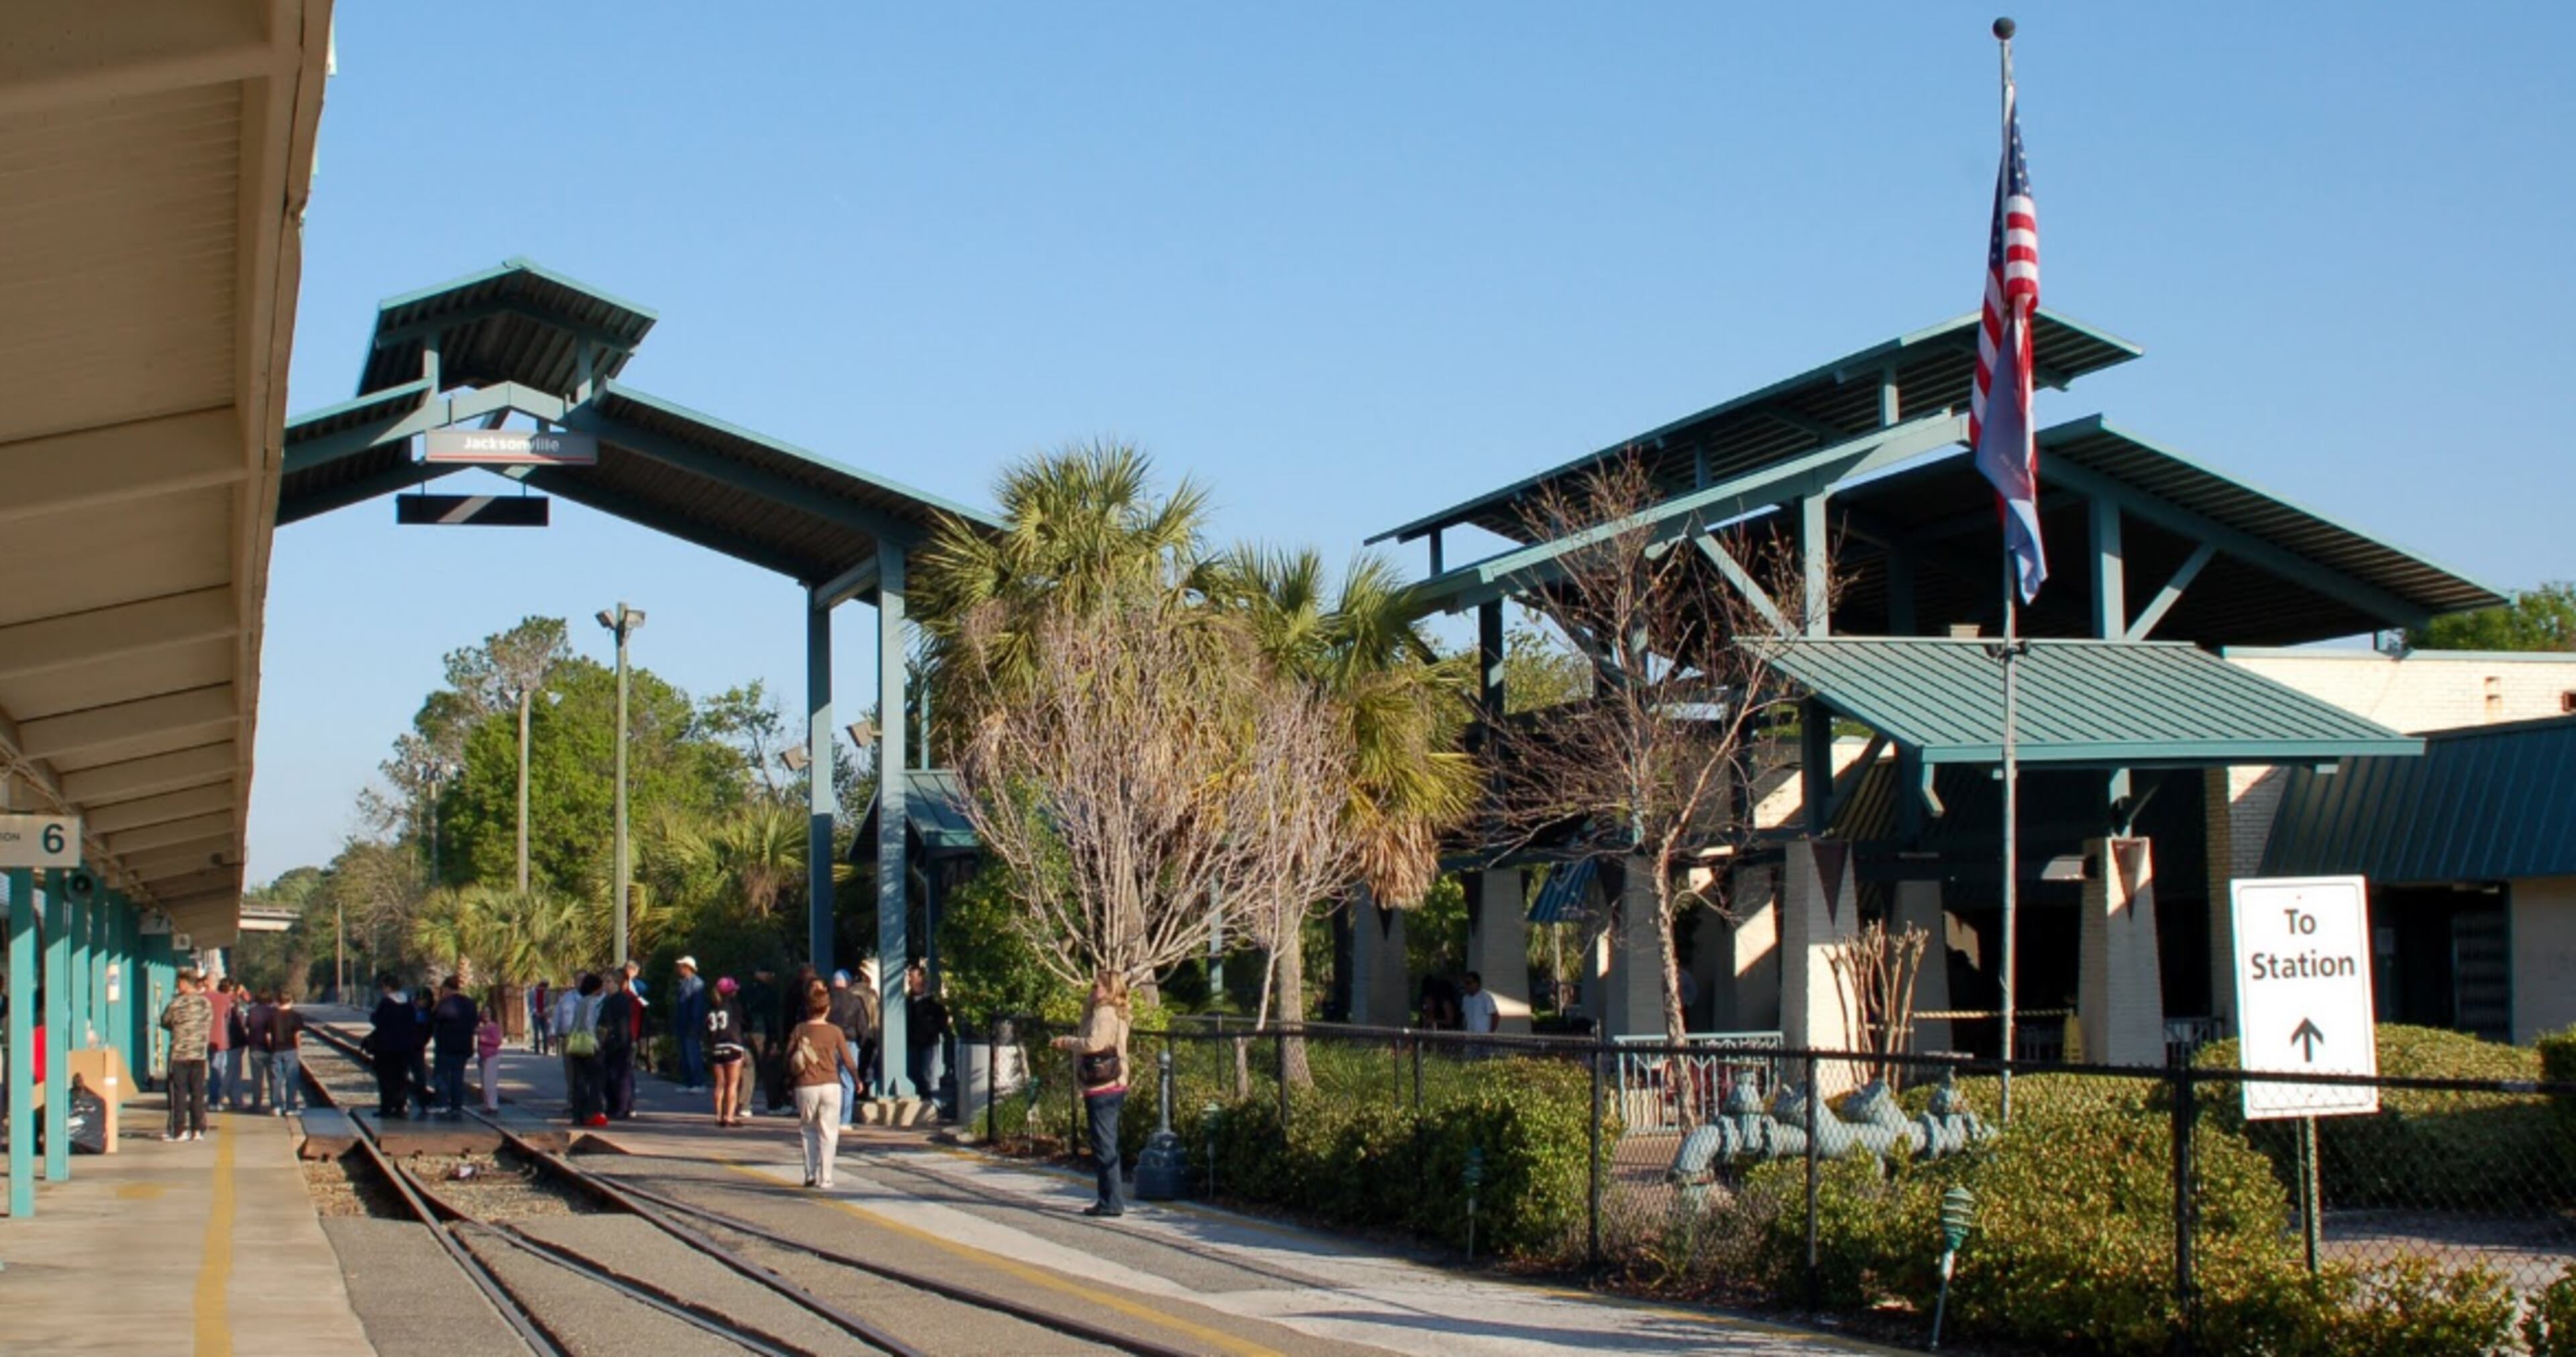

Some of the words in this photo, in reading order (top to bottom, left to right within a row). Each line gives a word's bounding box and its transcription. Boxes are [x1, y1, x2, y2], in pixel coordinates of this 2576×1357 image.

[464, 437, 559, 451] Jacksonville
[43, 823, 64, 855] 6
[2284, 909, 2317, 934] To
[2251, 950, 2355, 980] Station
